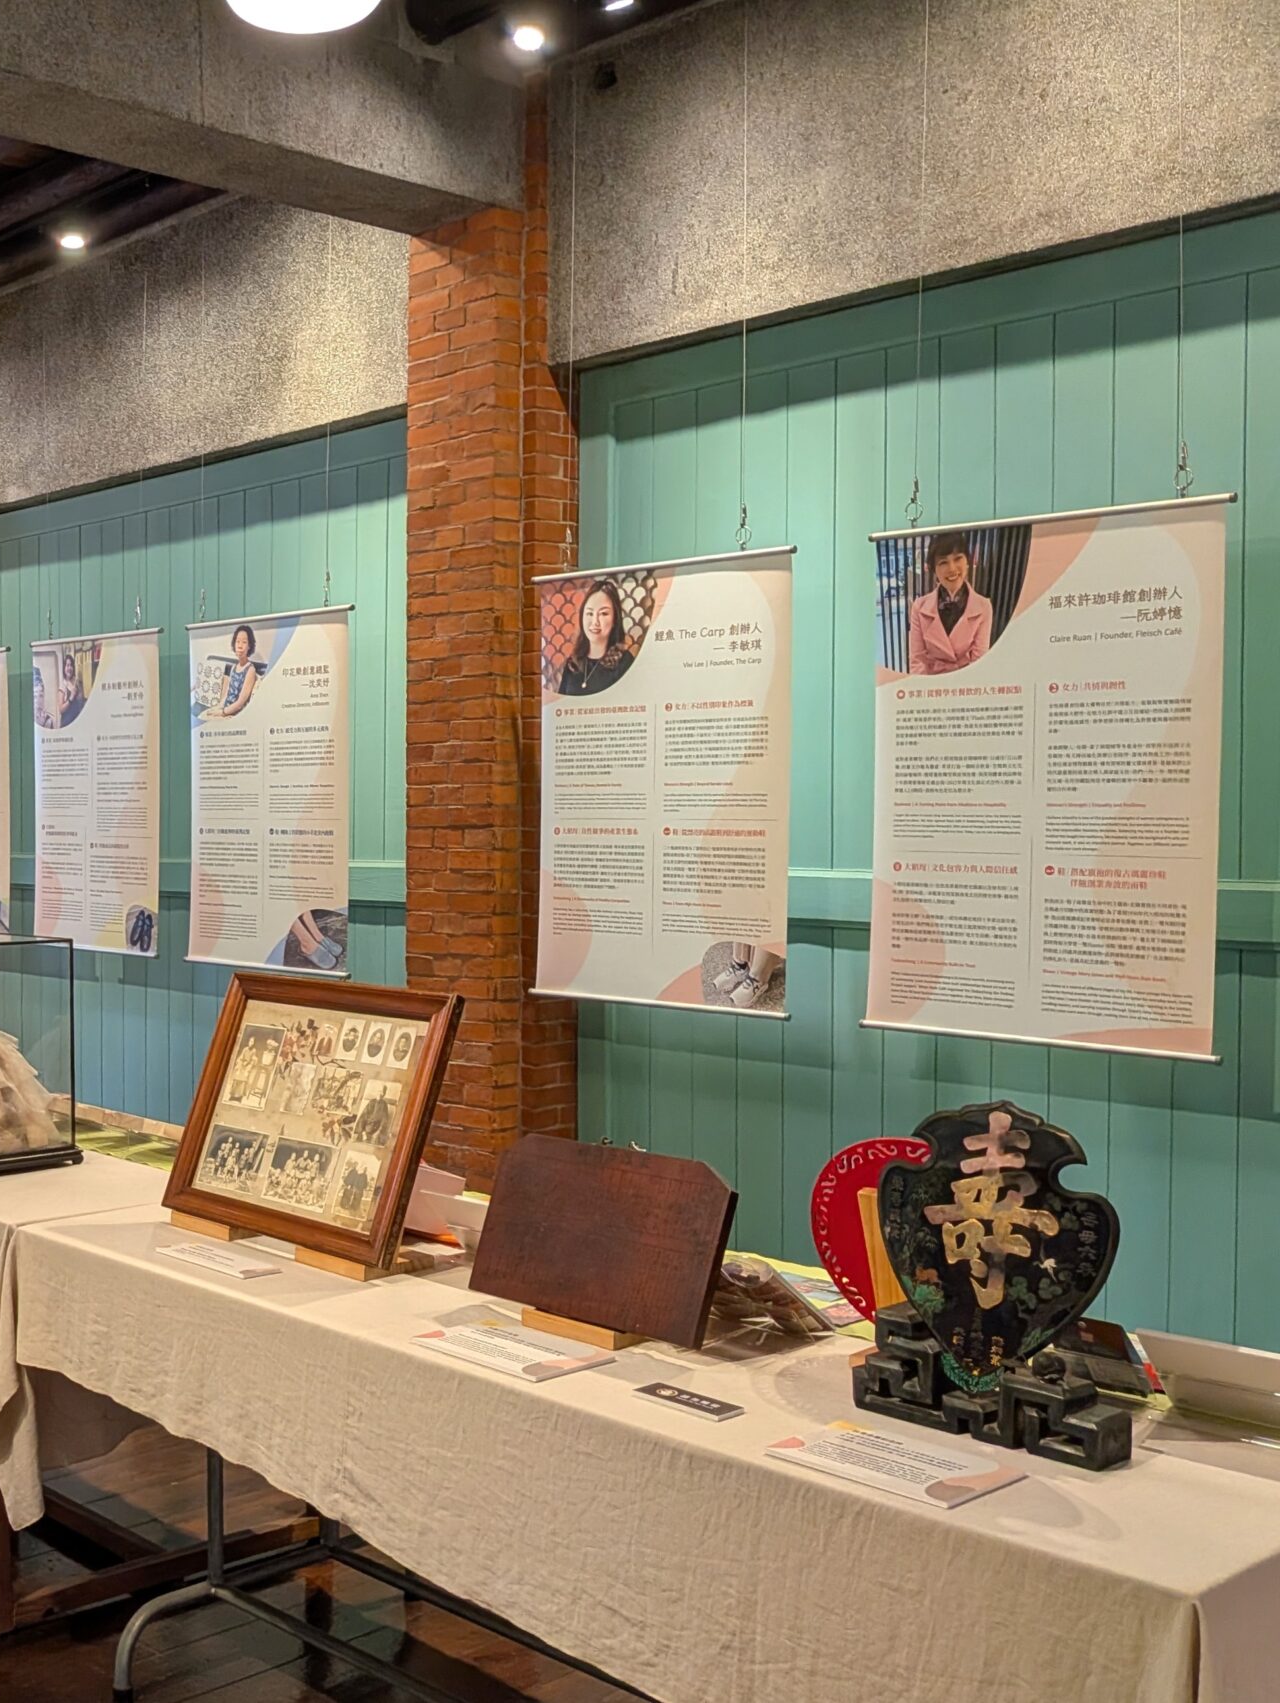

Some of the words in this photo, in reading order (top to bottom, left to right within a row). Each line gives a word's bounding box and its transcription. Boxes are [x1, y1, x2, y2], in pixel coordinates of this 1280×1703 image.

[679, 629, 697, 639] The
[700, 627, 725, 638] Carp
[729, 621, 763, 636] 創辦人
[1049, 634, 1071, 643] Claire
[1072, 633, 1092, 642] Ruan
[1100, 631, 1134, 641] Founder,
[1135, 629, 1163, 638] Fleisch
[1164, 627, 1183, 637] Café
[710, 659, 735, 667] Founder,
[923, 1111, 1060, 1310] 壽
